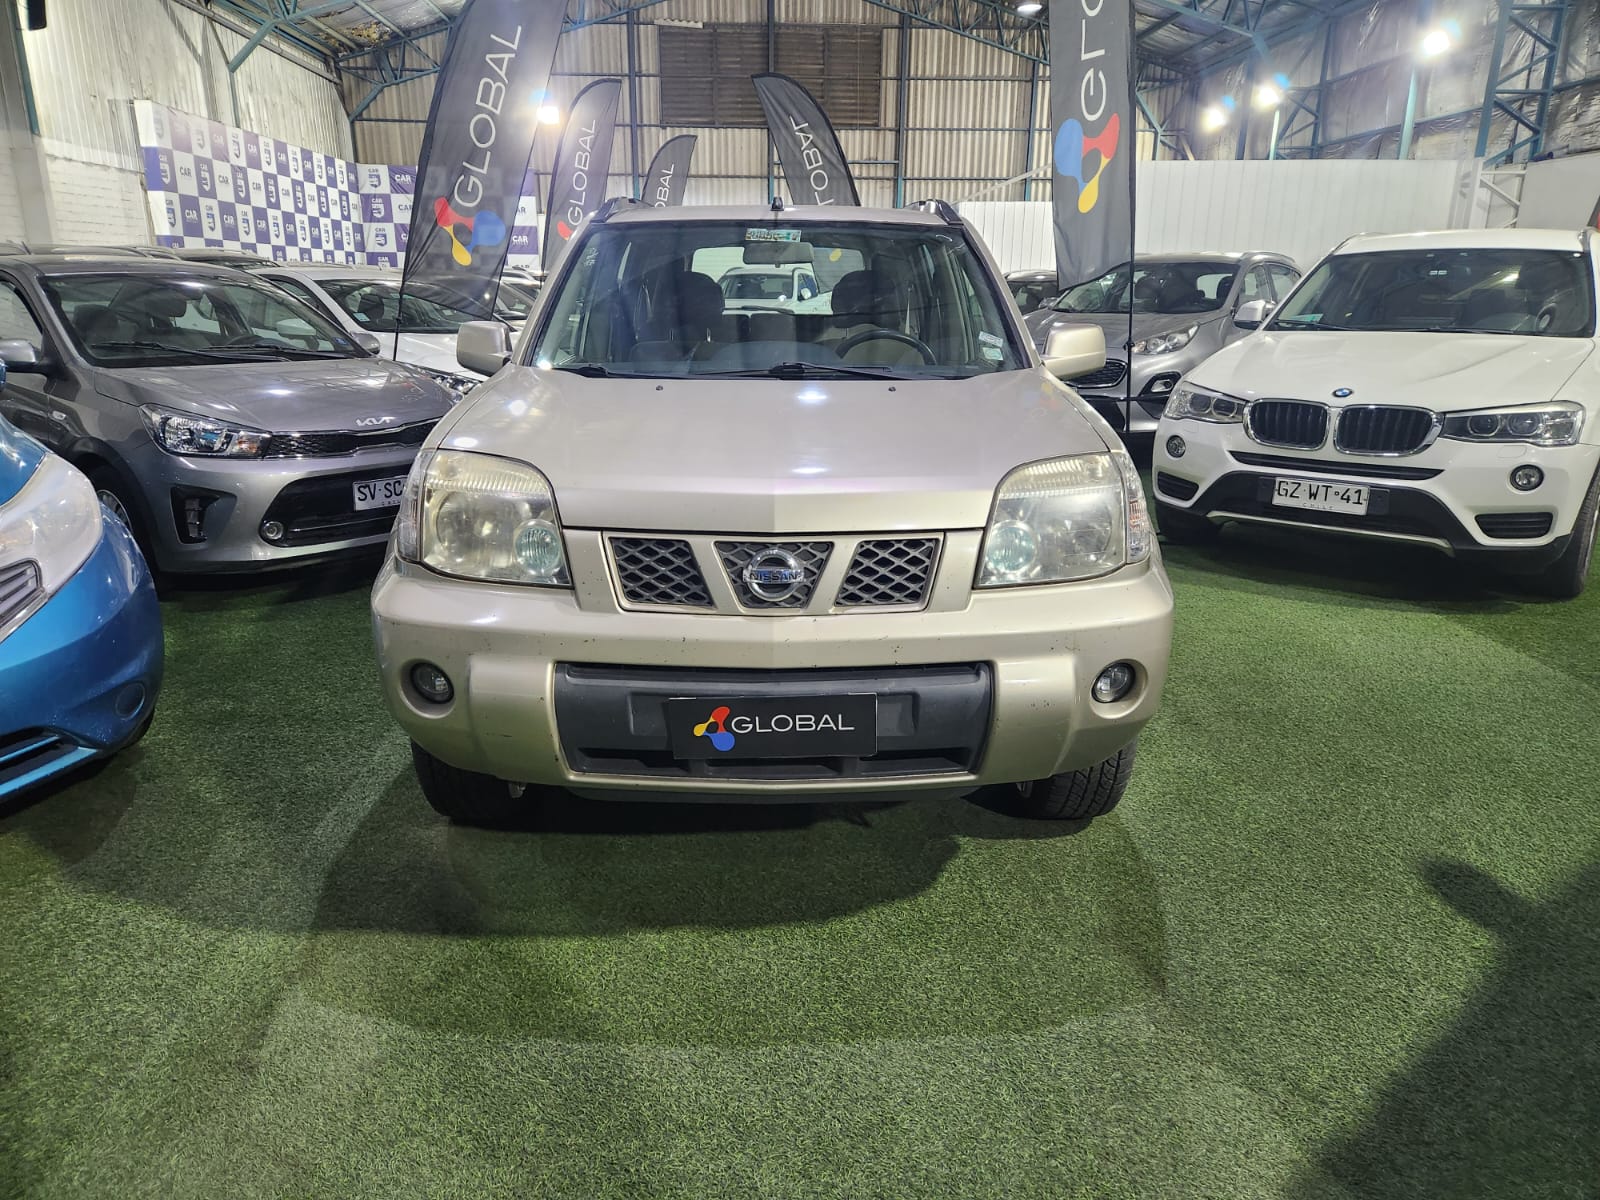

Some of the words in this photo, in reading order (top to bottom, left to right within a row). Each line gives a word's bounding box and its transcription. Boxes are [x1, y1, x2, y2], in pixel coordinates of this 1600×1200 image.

[453, 24, 522, 208] GLOBAL
[180, 166, 192, 177] CAR
[567, 119, 596, 226] GLOBAL
[218, 175, 229, 184] CAR
[394, 174, 411, 182] CAR
[185, 209, 198, 220] CAR
[223, 214, 234, 224] CAR
[749, 570, 798, 581] NISSAN
[731, 713, 855, 734] GLOBAL
